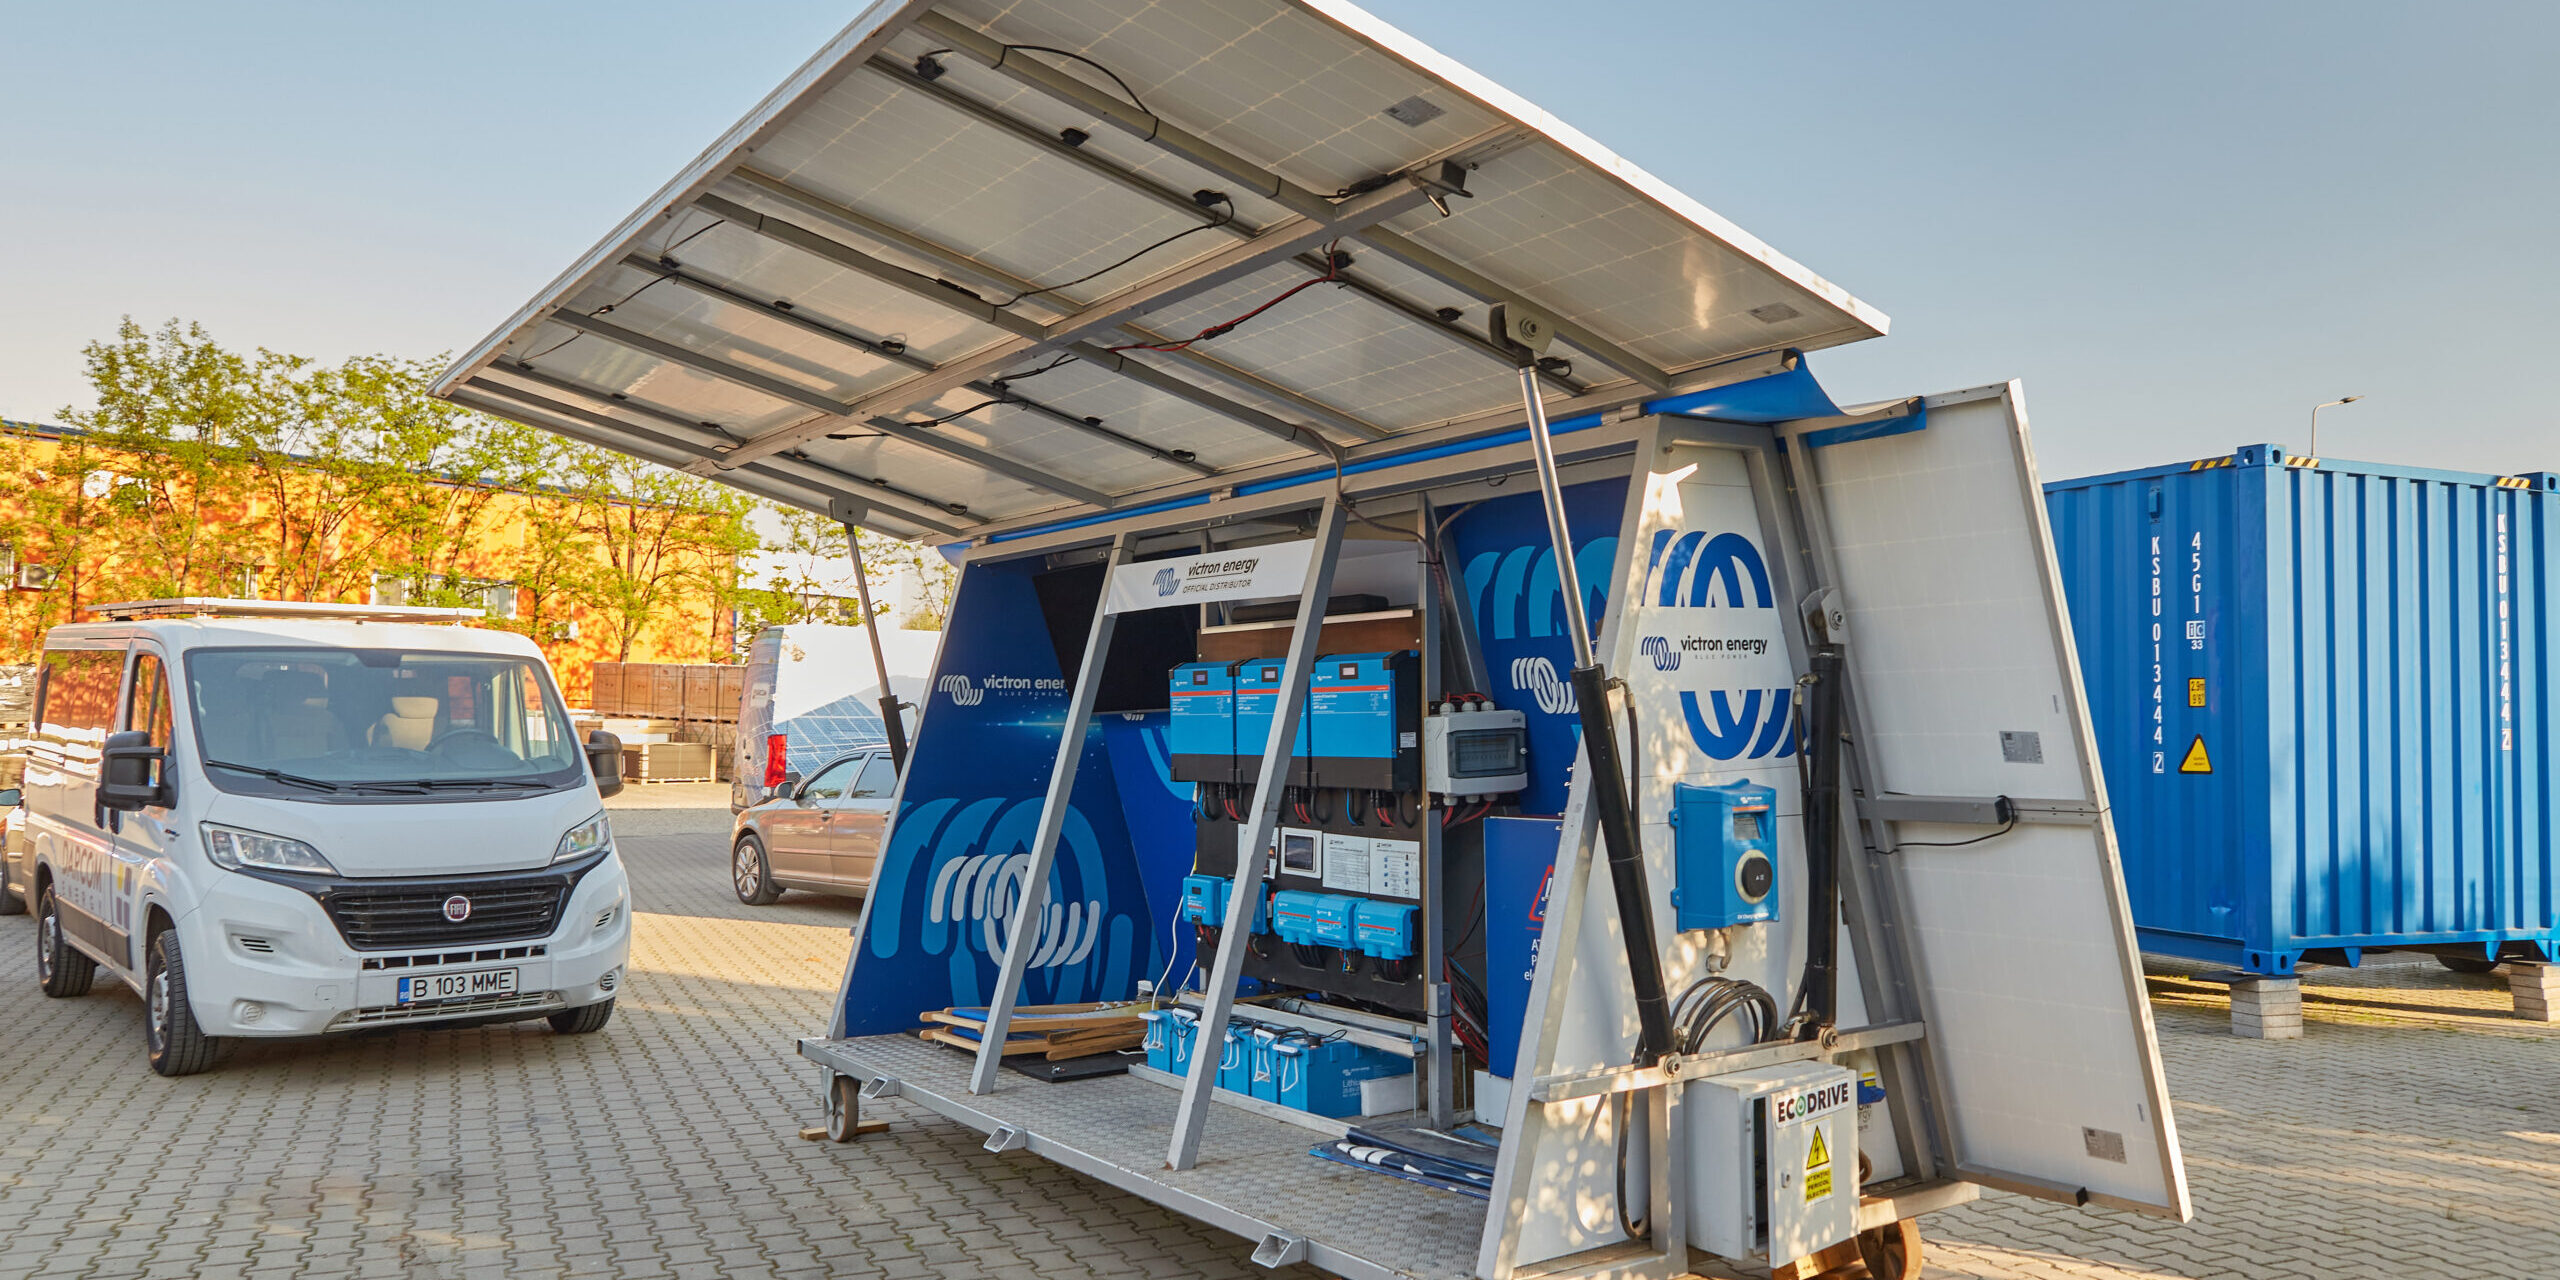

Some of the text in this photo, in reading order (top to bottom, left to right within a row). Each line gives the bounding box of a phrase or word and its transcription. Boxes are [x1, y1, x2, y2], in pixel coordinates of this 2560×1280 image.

[1187, 558, 1260, 577] victron energy
[2191, 531, 2201, 614] 45G1
[1182, 579, 1252, 594] OFFICIAL DISTRIBUTOR
[1680, 635, 1768, 655] victron energy
[2151, 536, 2163, 772] KSBU 013444 2
[2191, 640, 2203, 650] 33
[2499, 600, 2511, 722] 013444
[983, 674, 1064, 690] victron ener
[2502, 729, 2512, 750] 2
[62, 840, 102, 893] DARCOM
[450, 903, 465, 916] FIAT
[413, 971, 512, 998] B 103 MME
[1777, 1083, 1849, 1123] ECODRIVE
